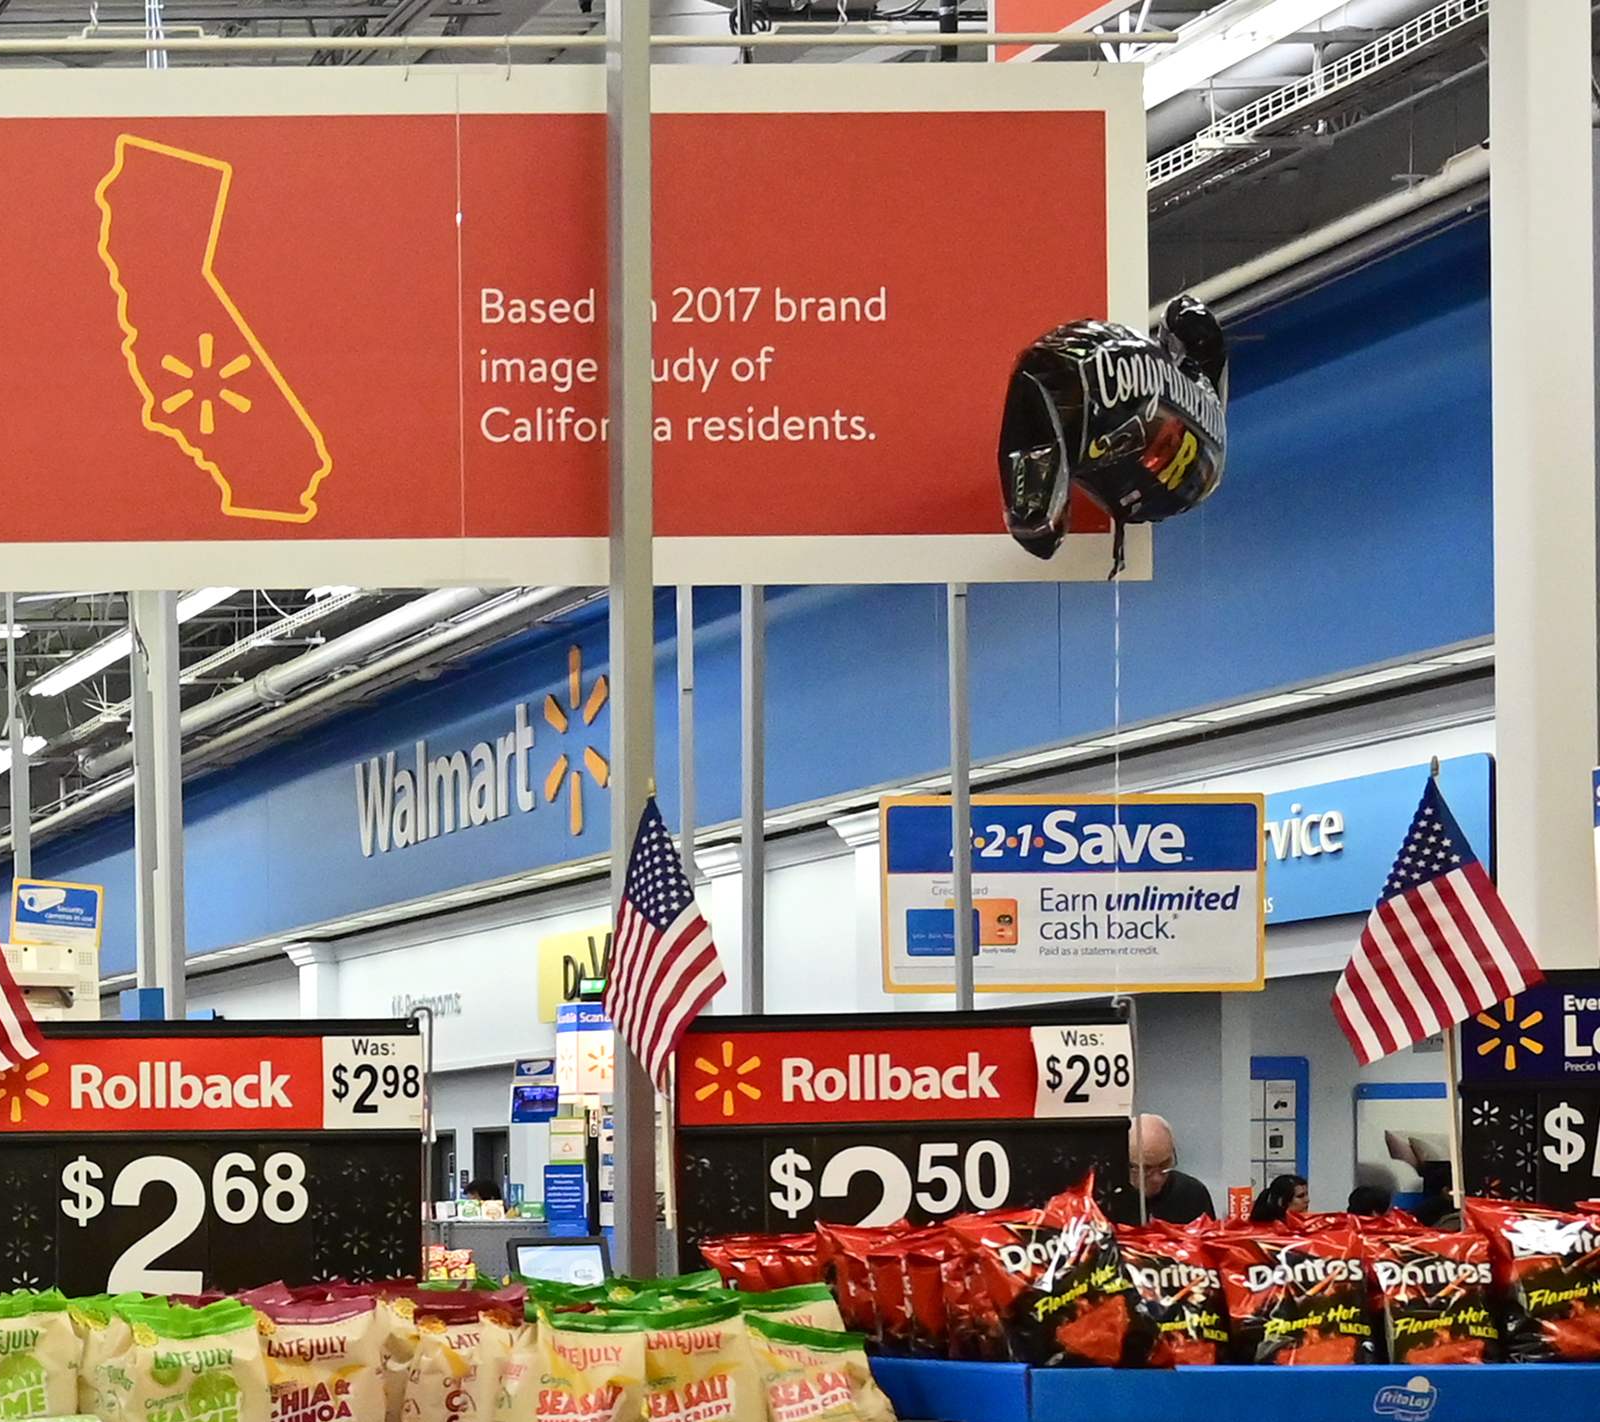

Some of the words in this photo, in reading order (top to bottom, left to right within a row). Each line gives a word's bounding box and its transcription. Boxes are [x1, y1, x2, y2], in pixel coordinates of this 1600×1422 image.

[480, 288, 596, 324] Based
[672, 288, 761, 324] 2017
[775, 286, 887, 324] brand
[480, 350, 598, 391] image
[651, 350, 714, 393] udy
[732, 346, 774, 385] of
[480, 405, 672, 444] Califora
[687, 405, 877, 444] residents.
[355, 703, 536, 858] Walmart
[1043, 809, 1186, 865] Save
[1264, 802, 1344, 861] rvice
[1040, 887, 1098, 913] Earn
[1105, 885, 1240, 912] unlimited
[1040, 914, 1099, 941] cash
[1039, 946, 1060, 956] Paid
[1061, 948, 1070, 956] as
[70, 1059, 292, 1110] Rollback
[351, 1037, 397, 1057] Was:
[780, 1050, 1001, 1104] Rollback
[1060, 1026, 1105, 1050] Was:
[1565, 1061, 1596, 1072] Precio
[1248, 1257, 1365, 1293] Doritos
[1374, 1261, 1493, 1291] Doritos
[1327, 1304, 1361, 1322] Hot
[1457, 1304, 1489, 1324] Hot
[267, 1339, 307, 1358] LATE
[302, 1336, 347, 1362] JULY
[681, 1331, 722, 1356] JULY
[191, 1348, 233, 1374] JULY
[576, 1345, 623, 1372] JULY
[536, 1390, 578, 1415] SEA
[684, 1374, 730, 1409] SALT
[769, 1381, 815, 1408] SEA
